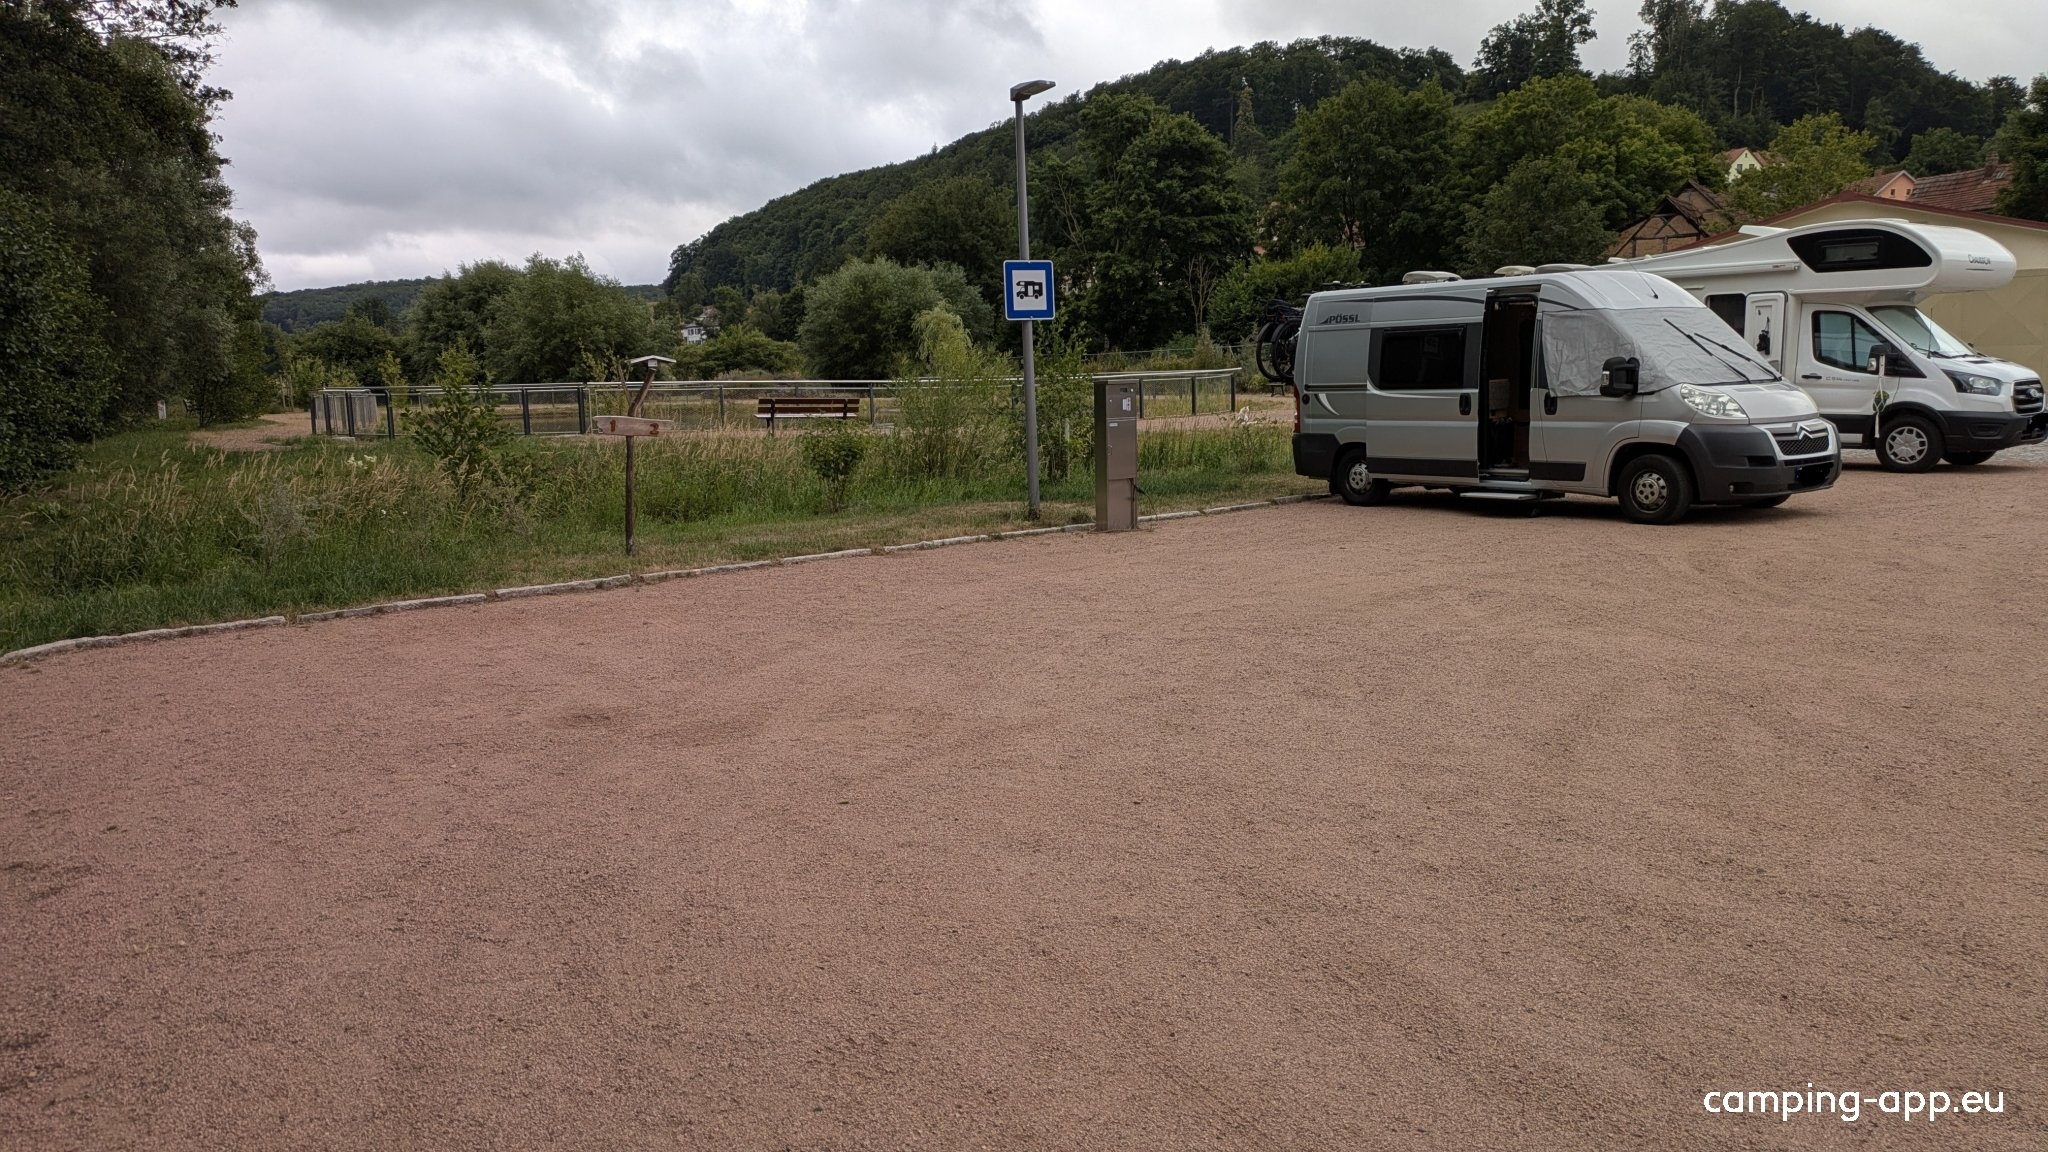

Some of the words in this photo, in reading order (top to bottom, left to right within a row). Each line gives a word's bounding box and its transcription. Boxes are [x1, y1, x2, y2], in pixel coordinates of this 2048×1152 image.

[1329, 313, 1360, 324] PÖSSL
[609, 420, 616, 433] 1
[649, 422, 660, 435] 2
